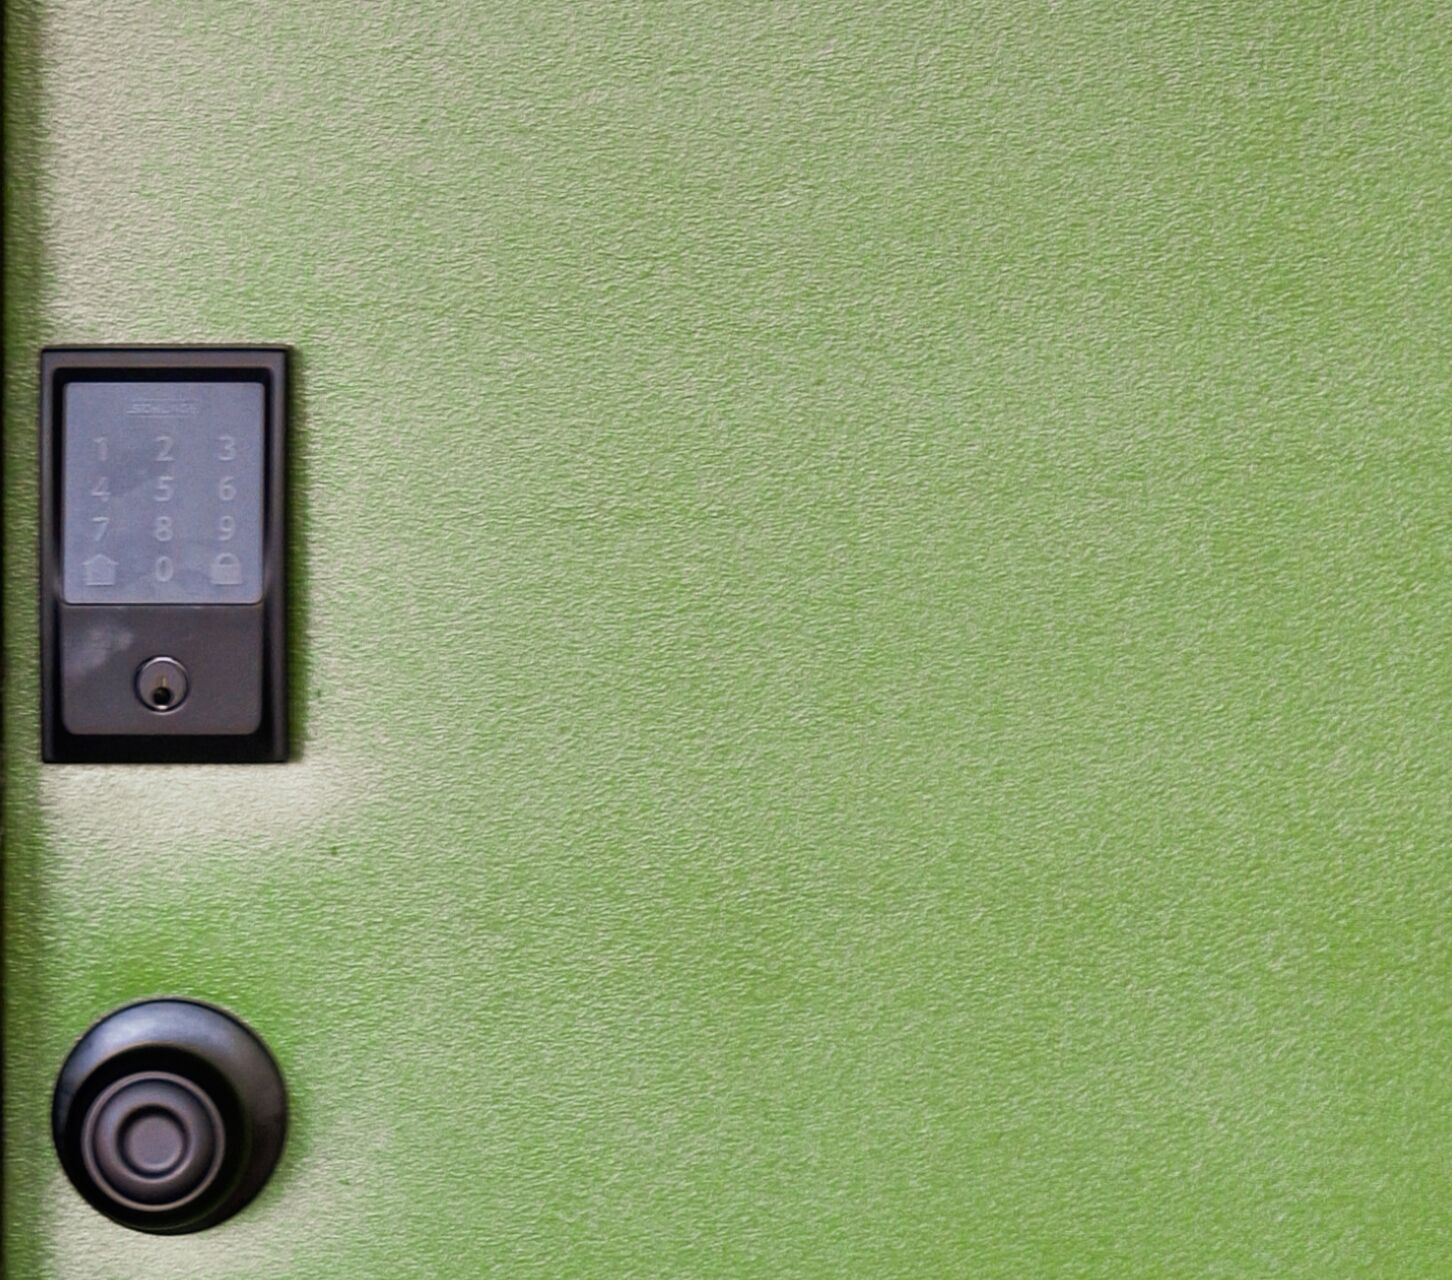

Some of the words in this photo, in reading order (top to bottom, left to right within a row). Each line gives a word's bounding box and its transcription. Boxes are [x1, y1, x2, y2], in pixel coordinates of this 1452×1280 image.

[93, 436, 109, 462] 1
[155, 436, 175, 462] 2
[217, 436, 237, 461] 3
[91, 476, 111, 502] 4
[153, 476, 174, 501] 5
[219, 476, 237, 501] 6
[92, 516, 110, 541] 7
[155, 516, 173, 541] 8
[218, 516, 236, 541] 9
[155, 556, 174, 582] 0
